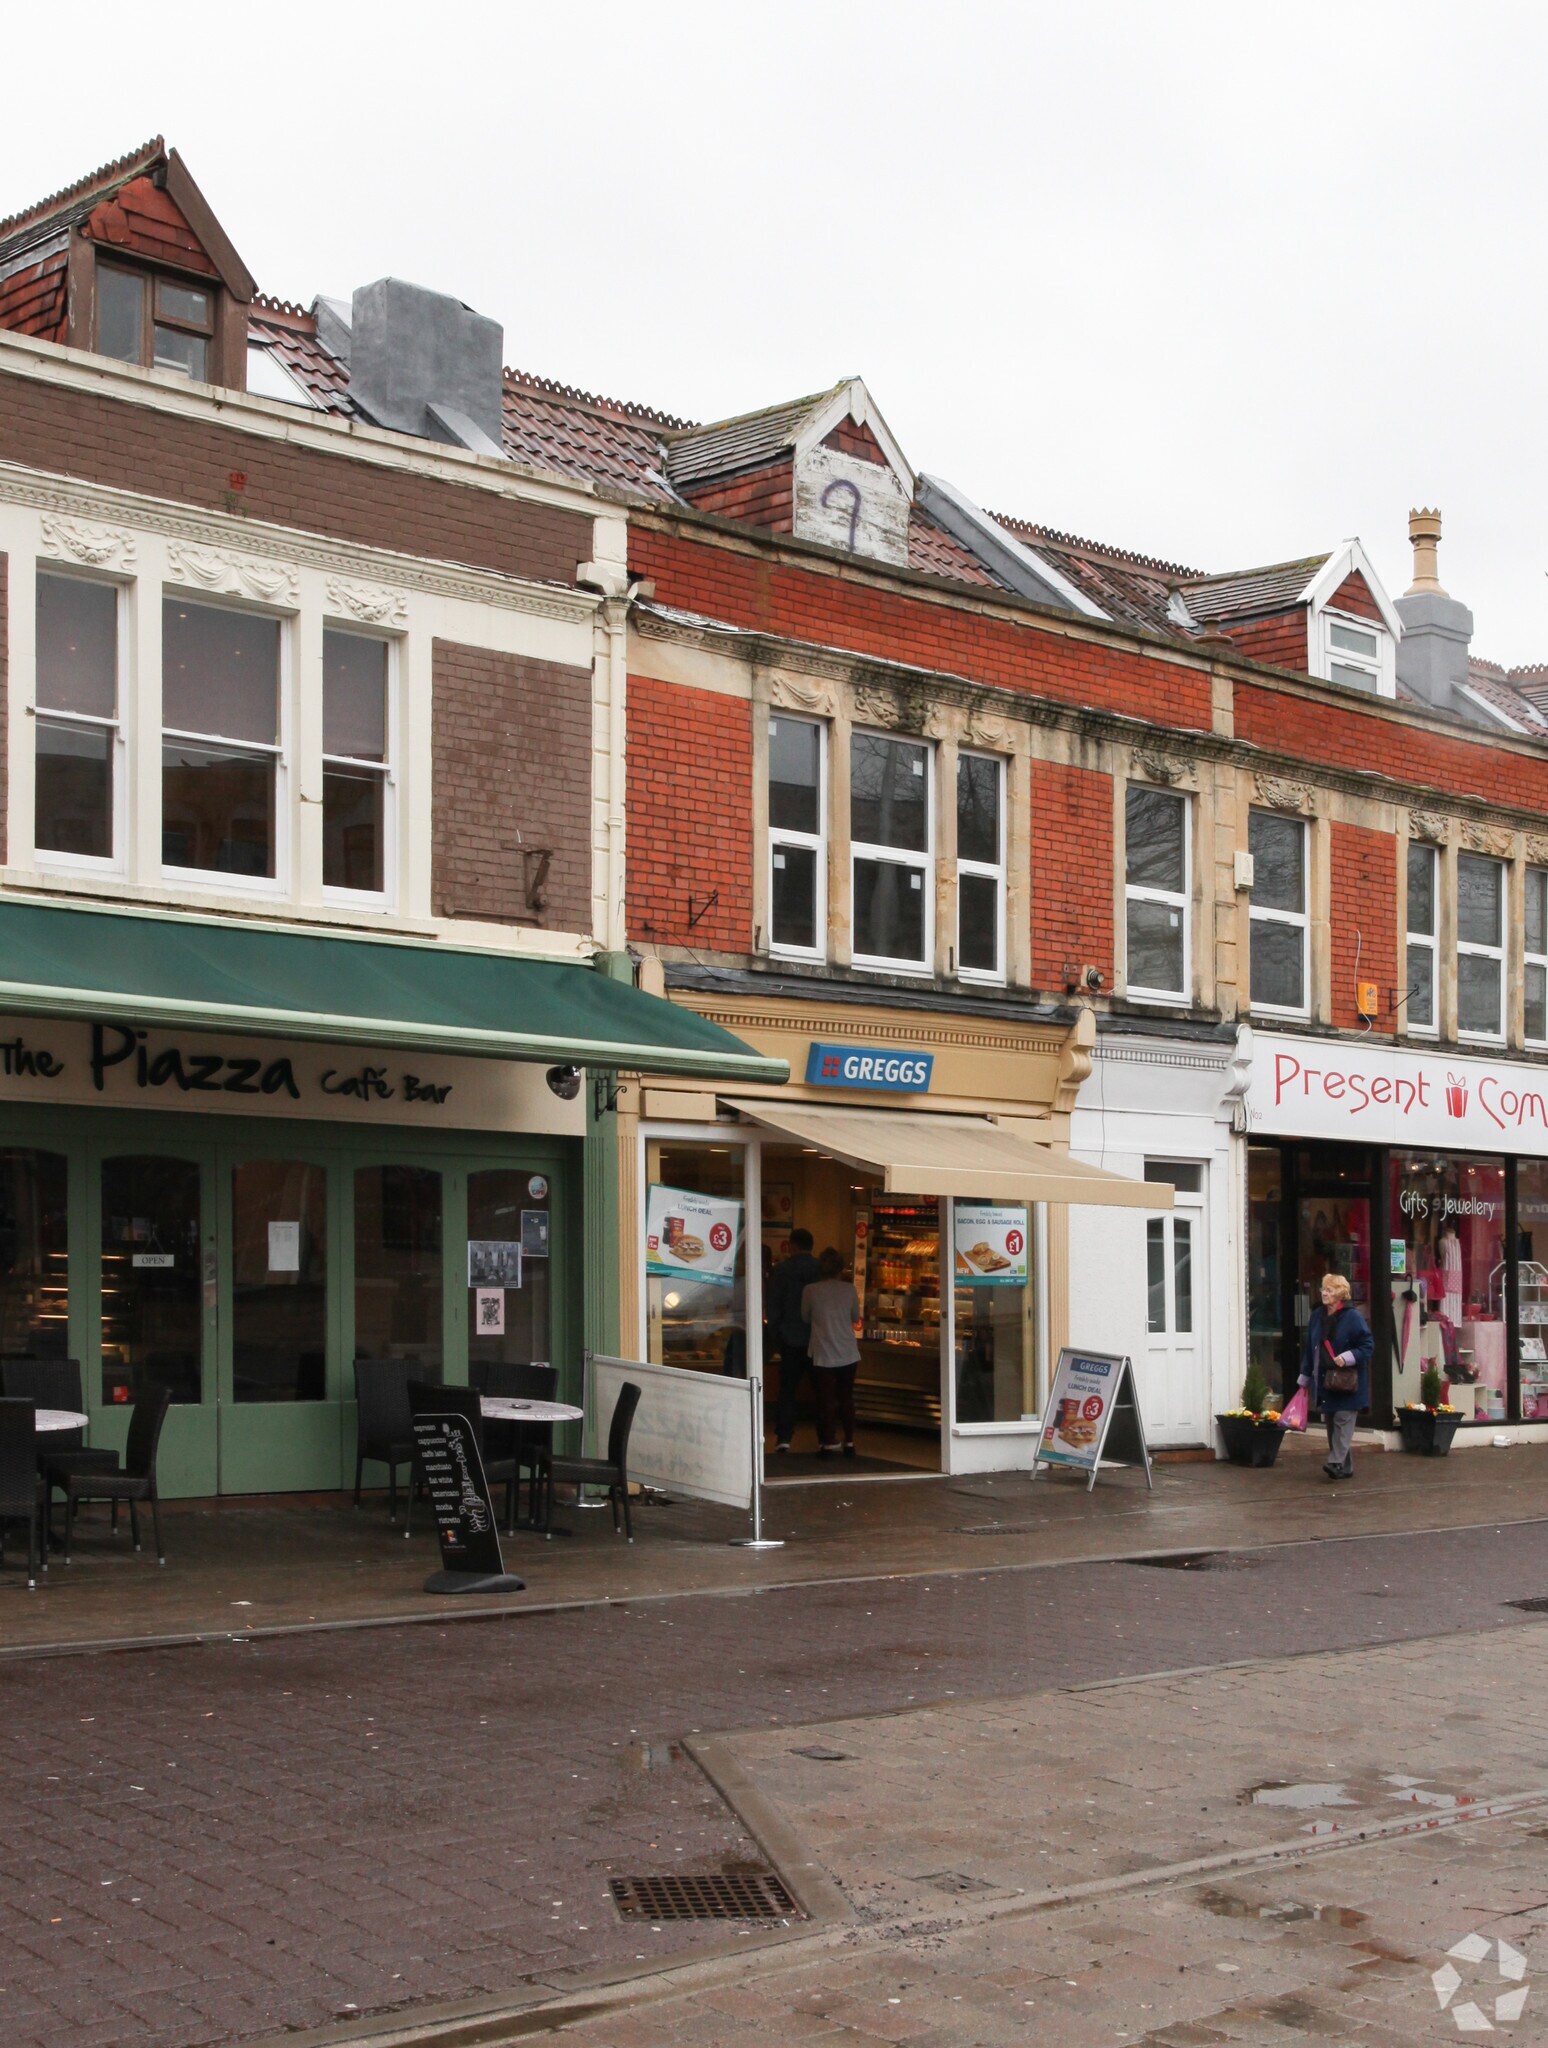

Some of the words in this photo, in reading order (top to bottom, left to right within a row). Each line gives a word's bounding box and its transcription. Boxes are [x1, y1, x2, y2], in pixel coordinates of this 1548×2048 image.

[0, 1037, 64, 1077] The
[90, 1024, 300, 1099] Piazza
[321, 1066, 395, 1101] Café
[403, 1074, 452, 1104] Bar
[844, 1056, 927, 1084] GREGGS
[1275, 1054, 1430, 1114] Present
[1400, 1189, 1428, 1219] Gifts
[1440, 1194, 1496, 1222] Jewellery
[713, 1231, 727, 1245] £3
[1009, 1236, 1020, 1252] £1
[141, 1256, 166, 1265] OPEN
[1080, 1361, 1109, 1373] GREGGS
[1067, 1383, 1087, 1391] LUNCH
[1087, 1386, 1102, 1395] DEAL
[1086, 1403, 1099, 1416] £3
